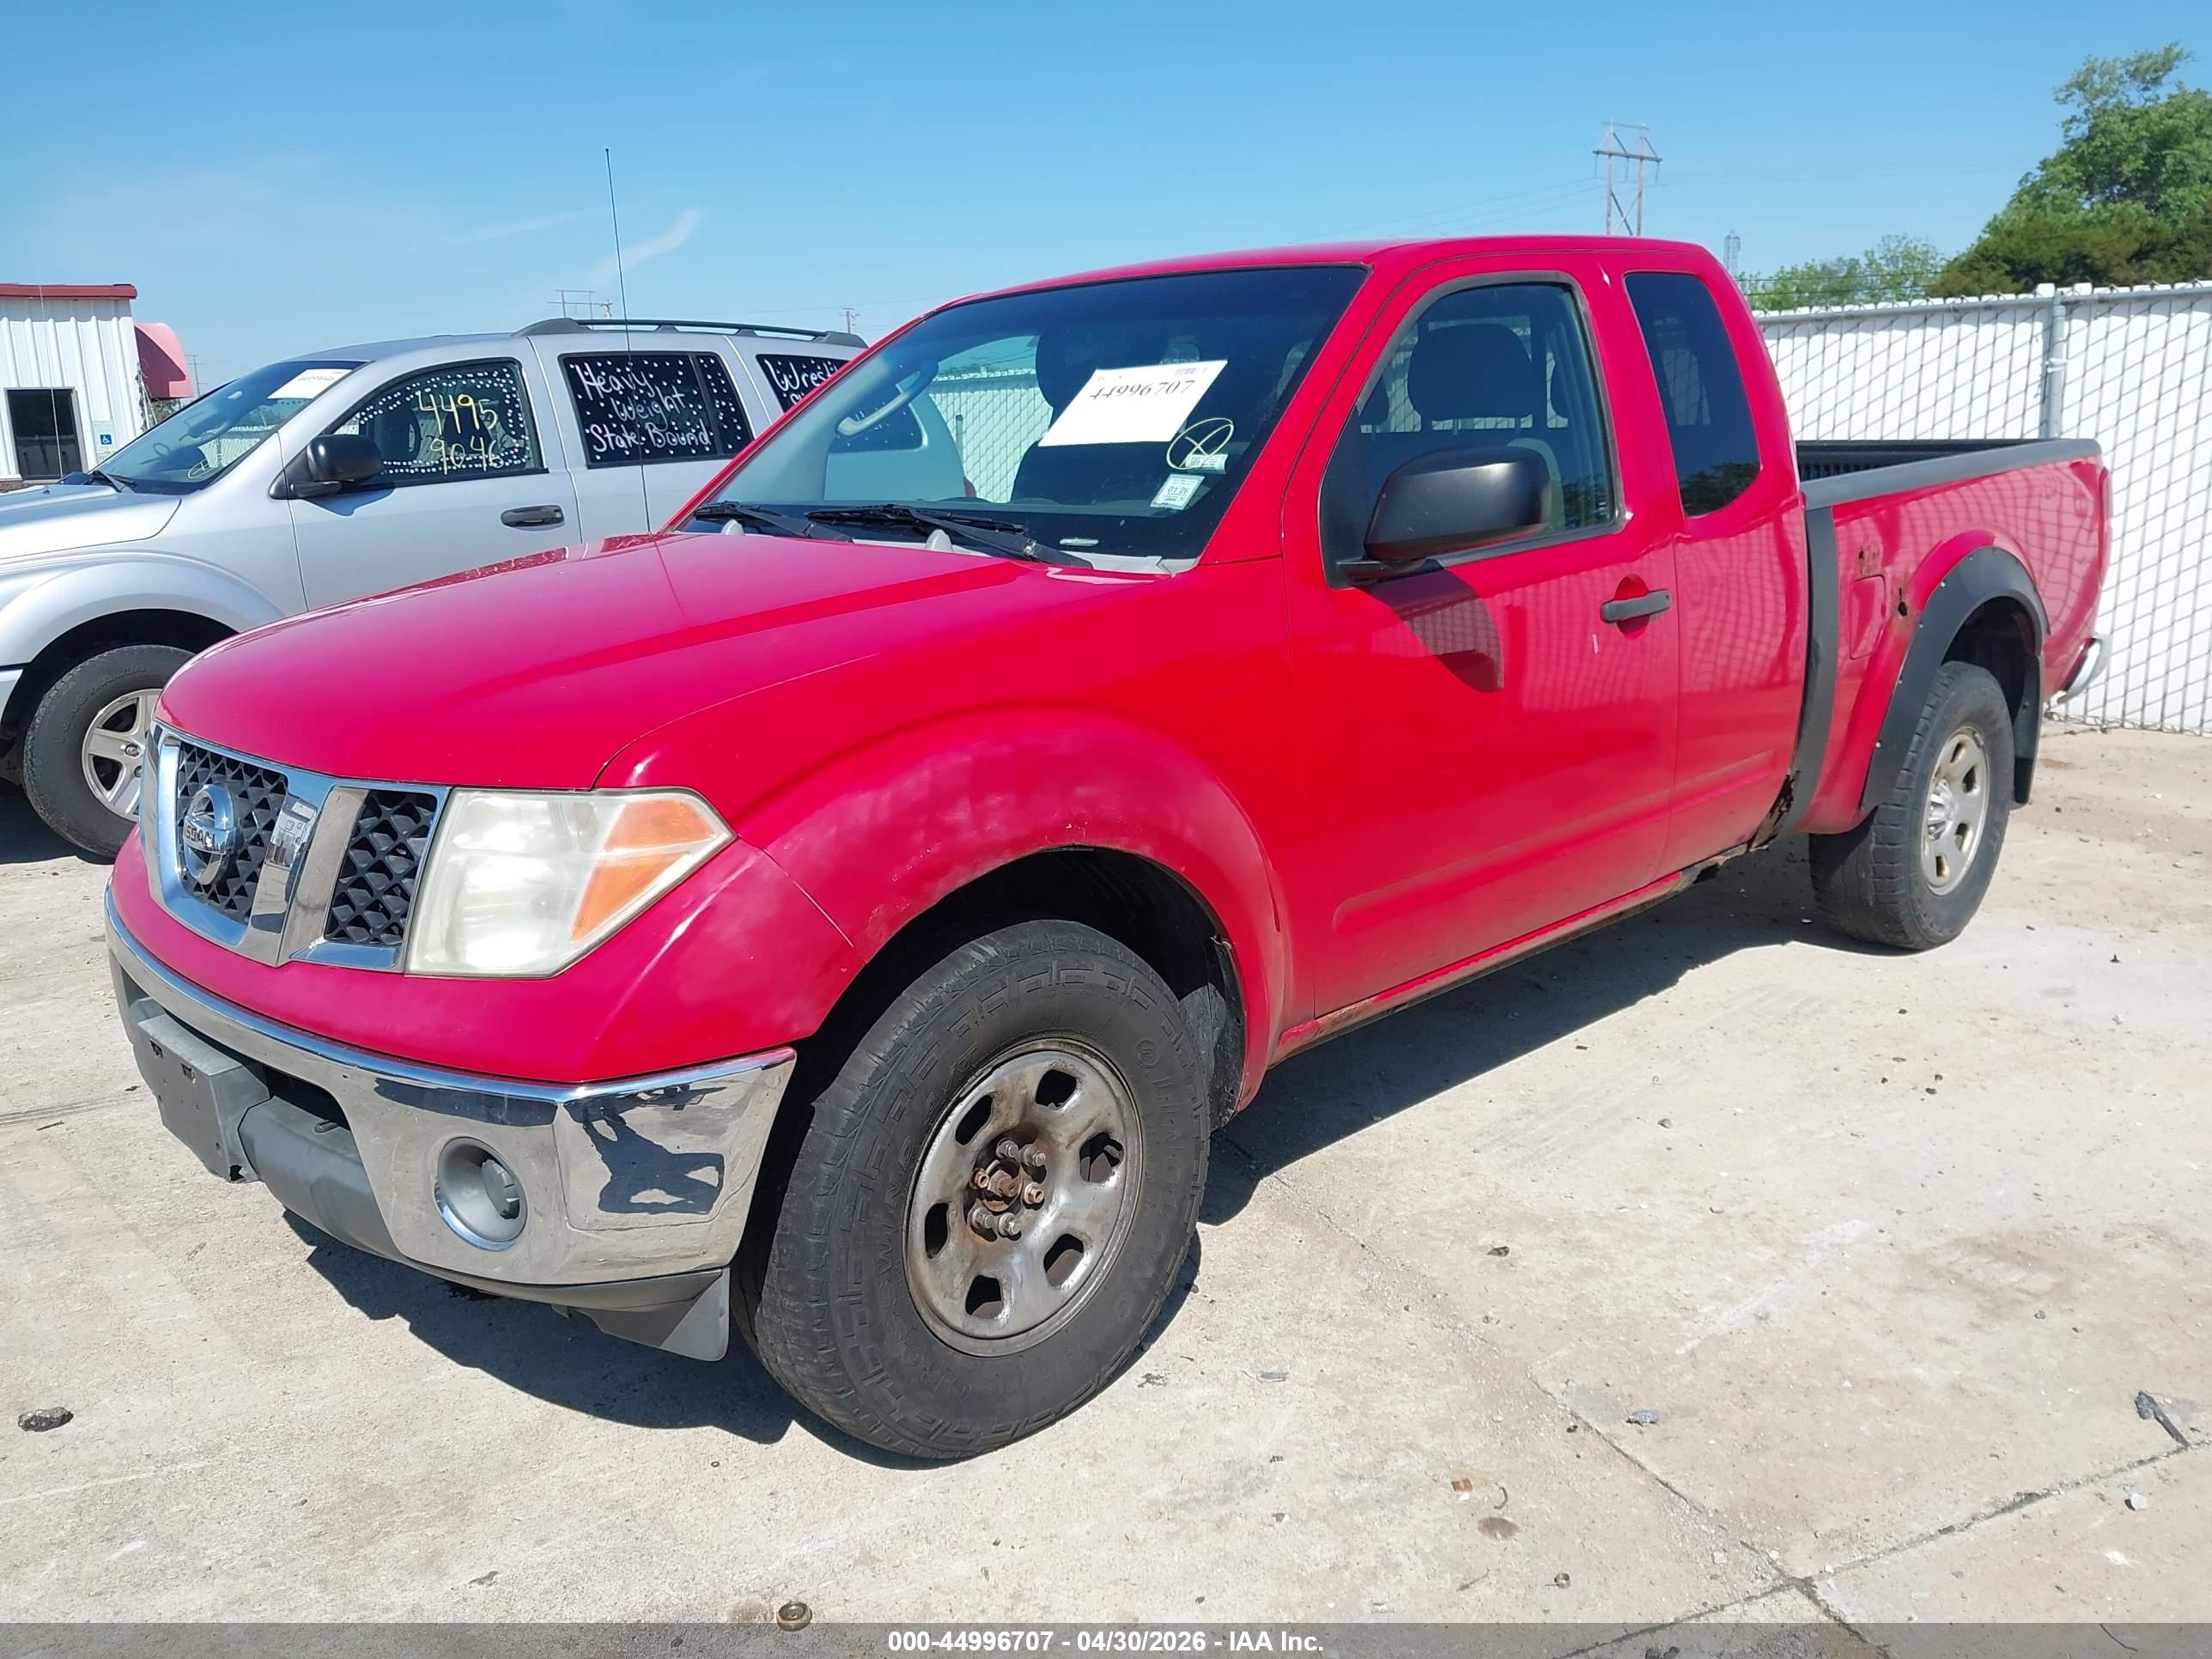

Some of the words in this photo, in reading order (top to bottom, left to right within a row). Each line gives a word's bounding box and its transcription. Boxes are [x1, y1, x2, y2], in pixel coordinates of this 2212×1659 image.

[574, 362, 656, 401] Heavy
[416, 391, 498, 436] 4495
[610, 385, 686, 432] Weight
[429, 435, 504, 476] 9046
[590, 423, 645, 453] State
[645, 418, 713, 448] Bound
